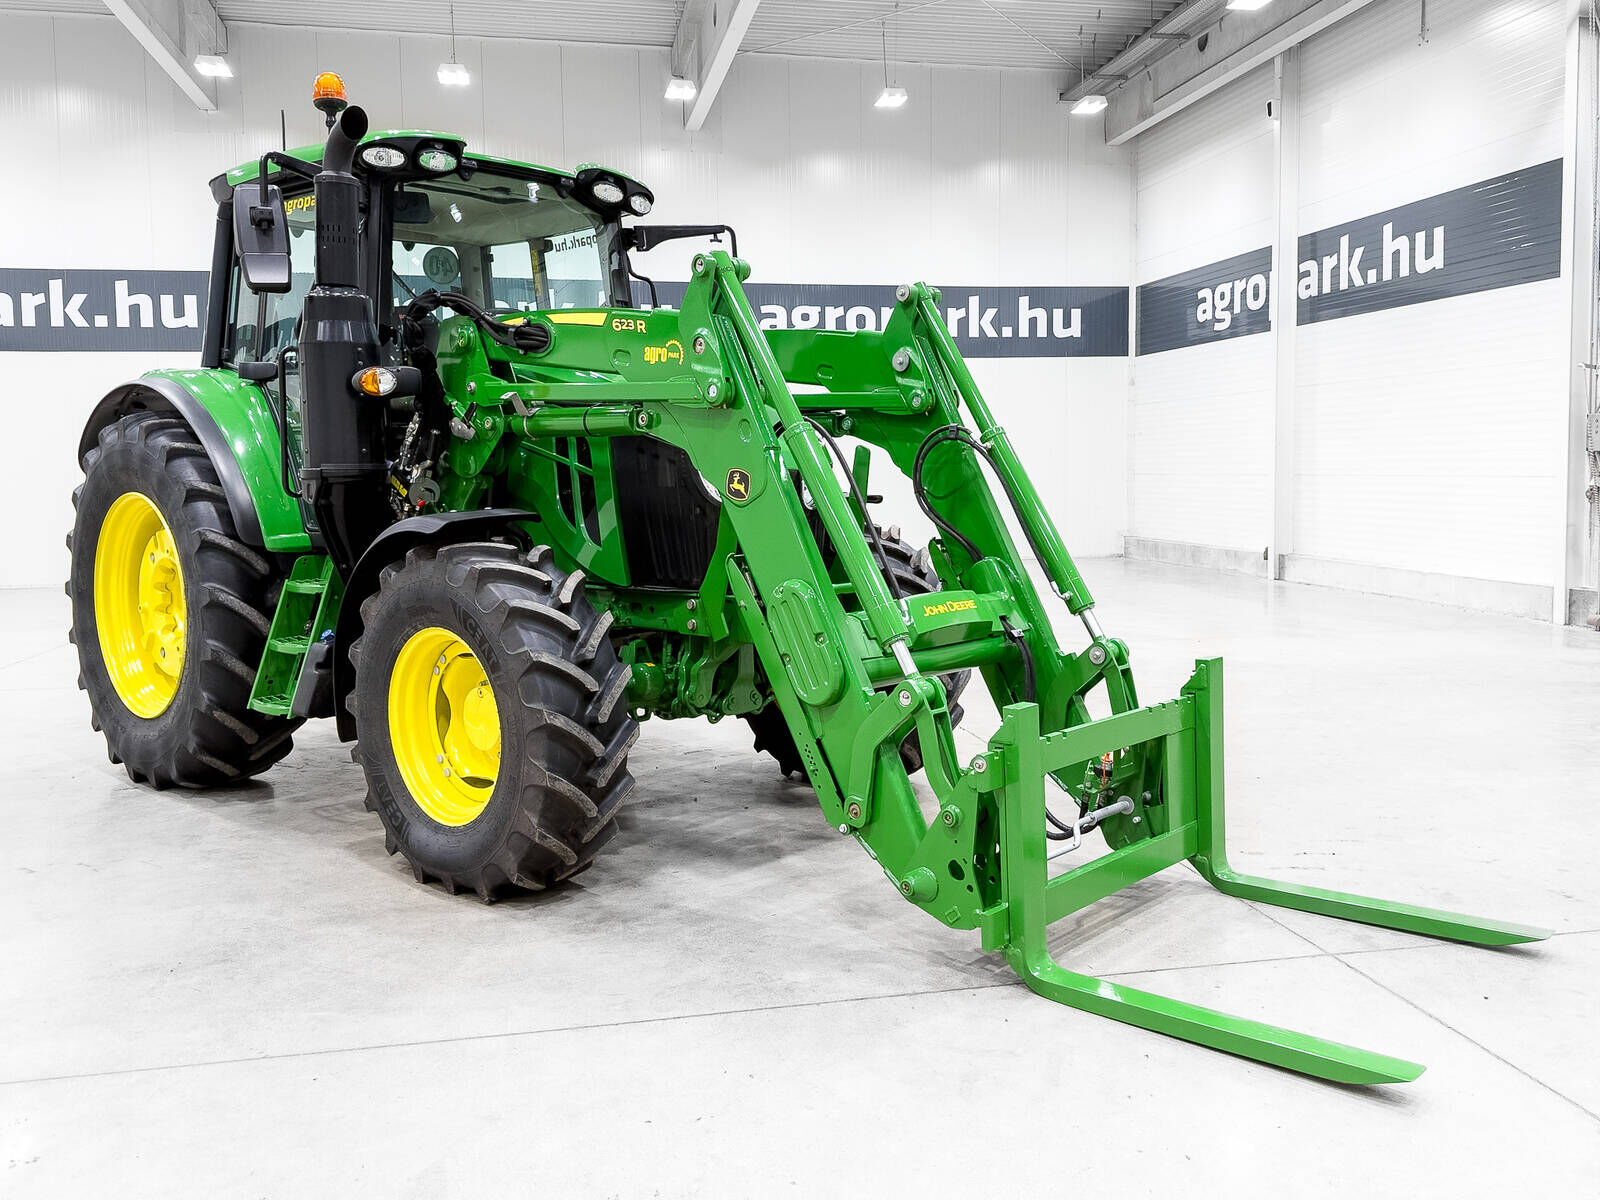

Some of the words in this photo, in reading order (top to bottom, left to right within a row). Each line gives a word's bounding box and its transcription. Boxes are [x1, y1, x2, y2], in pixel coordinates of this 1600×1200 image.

[1196, 222, 1445, 331] agroark.hu
[612, 318, 635, 332] 623
[636, 319, 647, 334] R
[643, 346, 668, 365] agro
[923, 604, 949, 617] JOHN
[945, 599, 977, 612] DEERE
